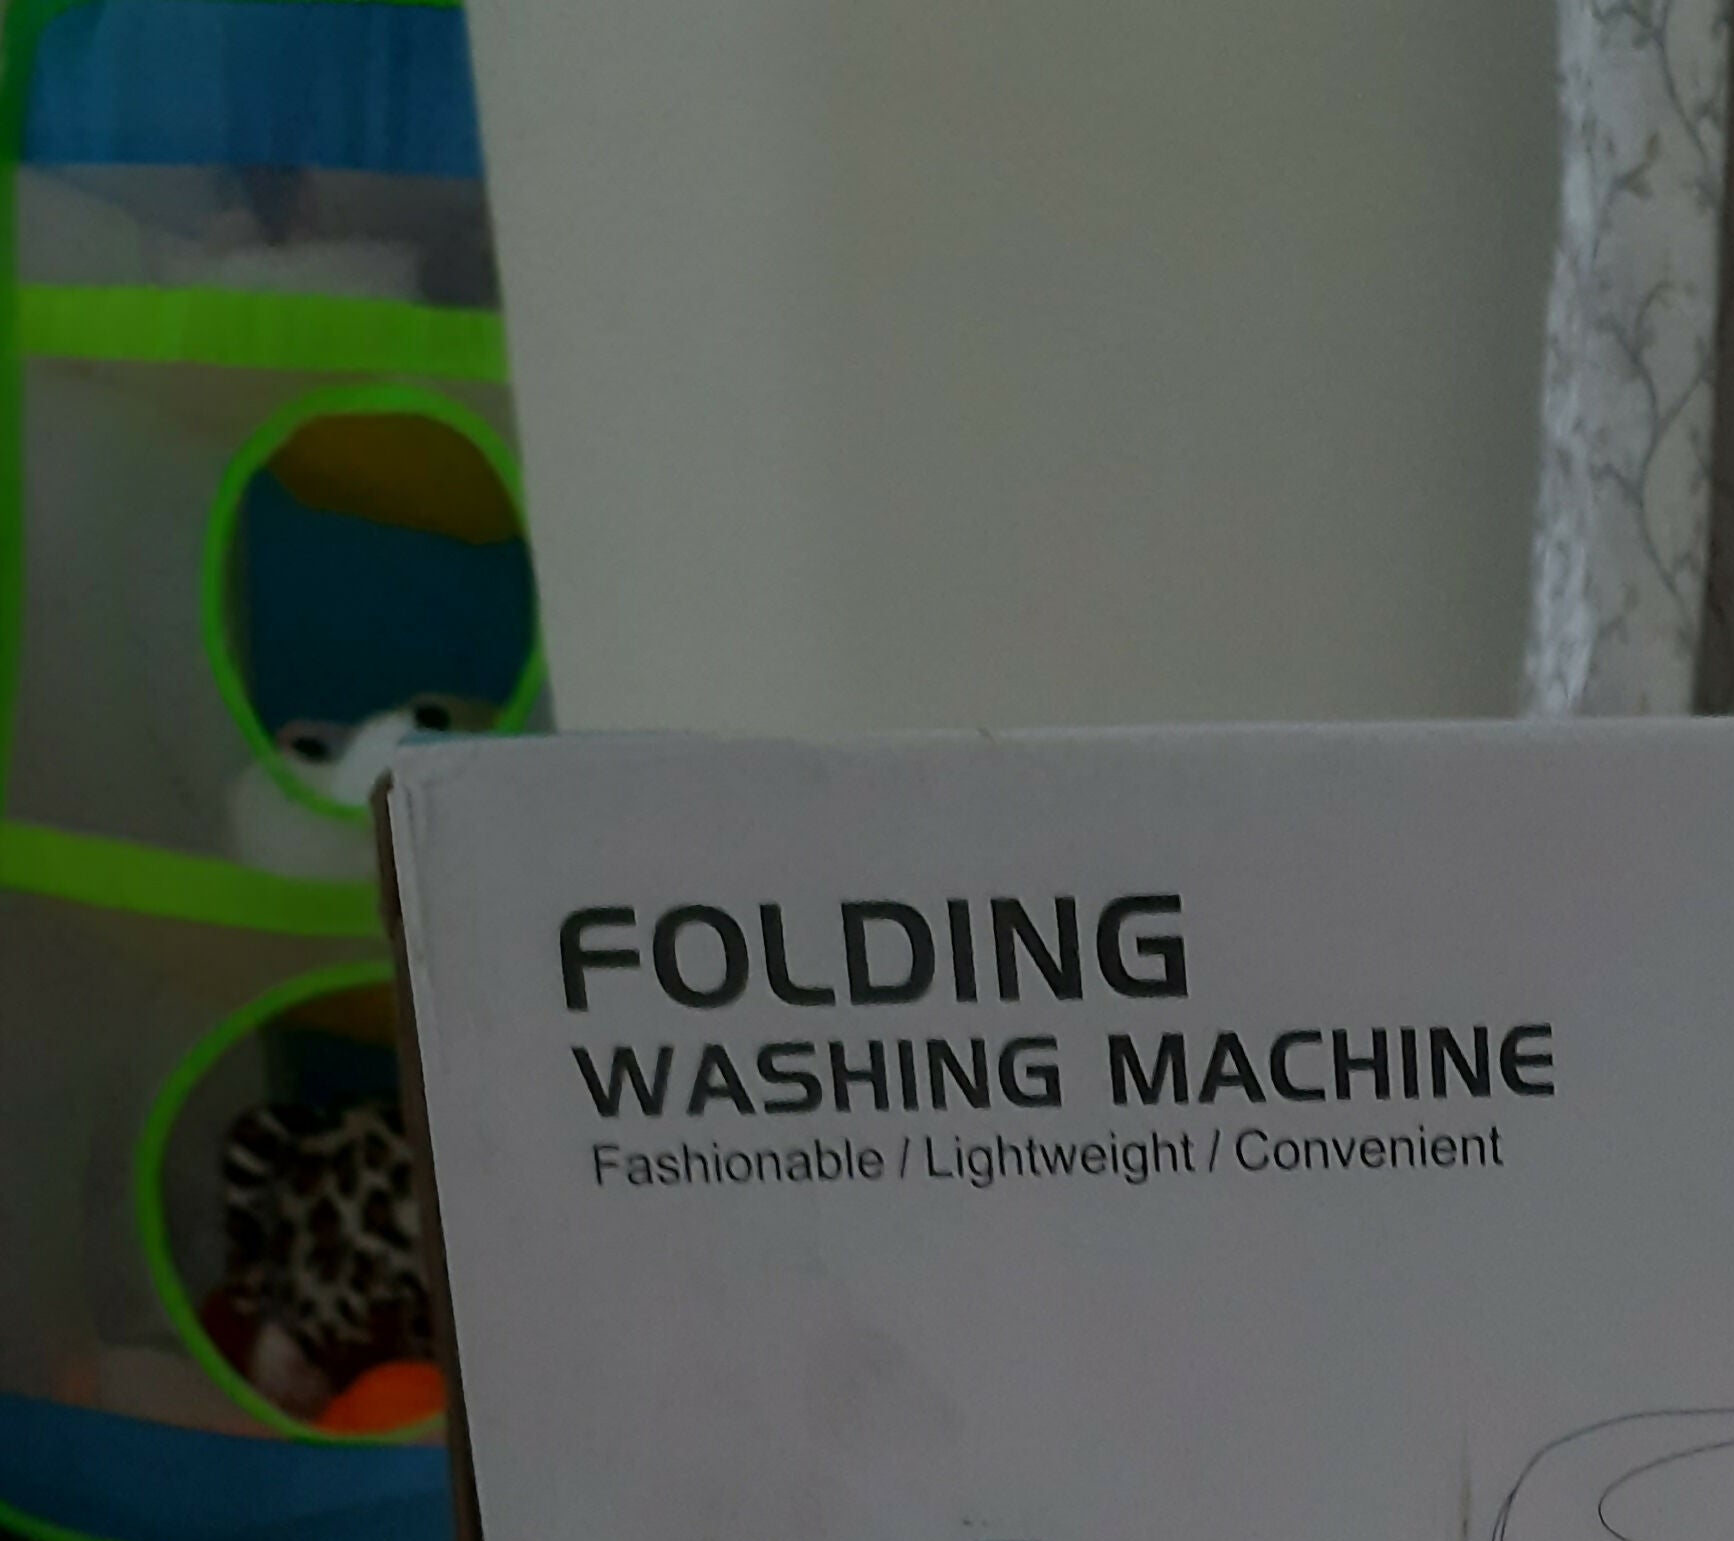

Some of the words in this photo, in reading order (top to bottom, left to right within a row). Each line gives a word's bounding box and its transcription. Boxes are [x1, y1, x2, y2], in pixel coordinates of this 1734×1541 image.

[559, 894, 1190, 1014] FOLDING
[571, 1035, 1064, 1119] WASHING
[1108, 1023, 1557, 1107] MACHINE
[592, 1137, 886, 1188] Fashionable
[924, 1131, 1198, 1190] Lightweight
[1235, 1125, 1506, 1174] Convenient
